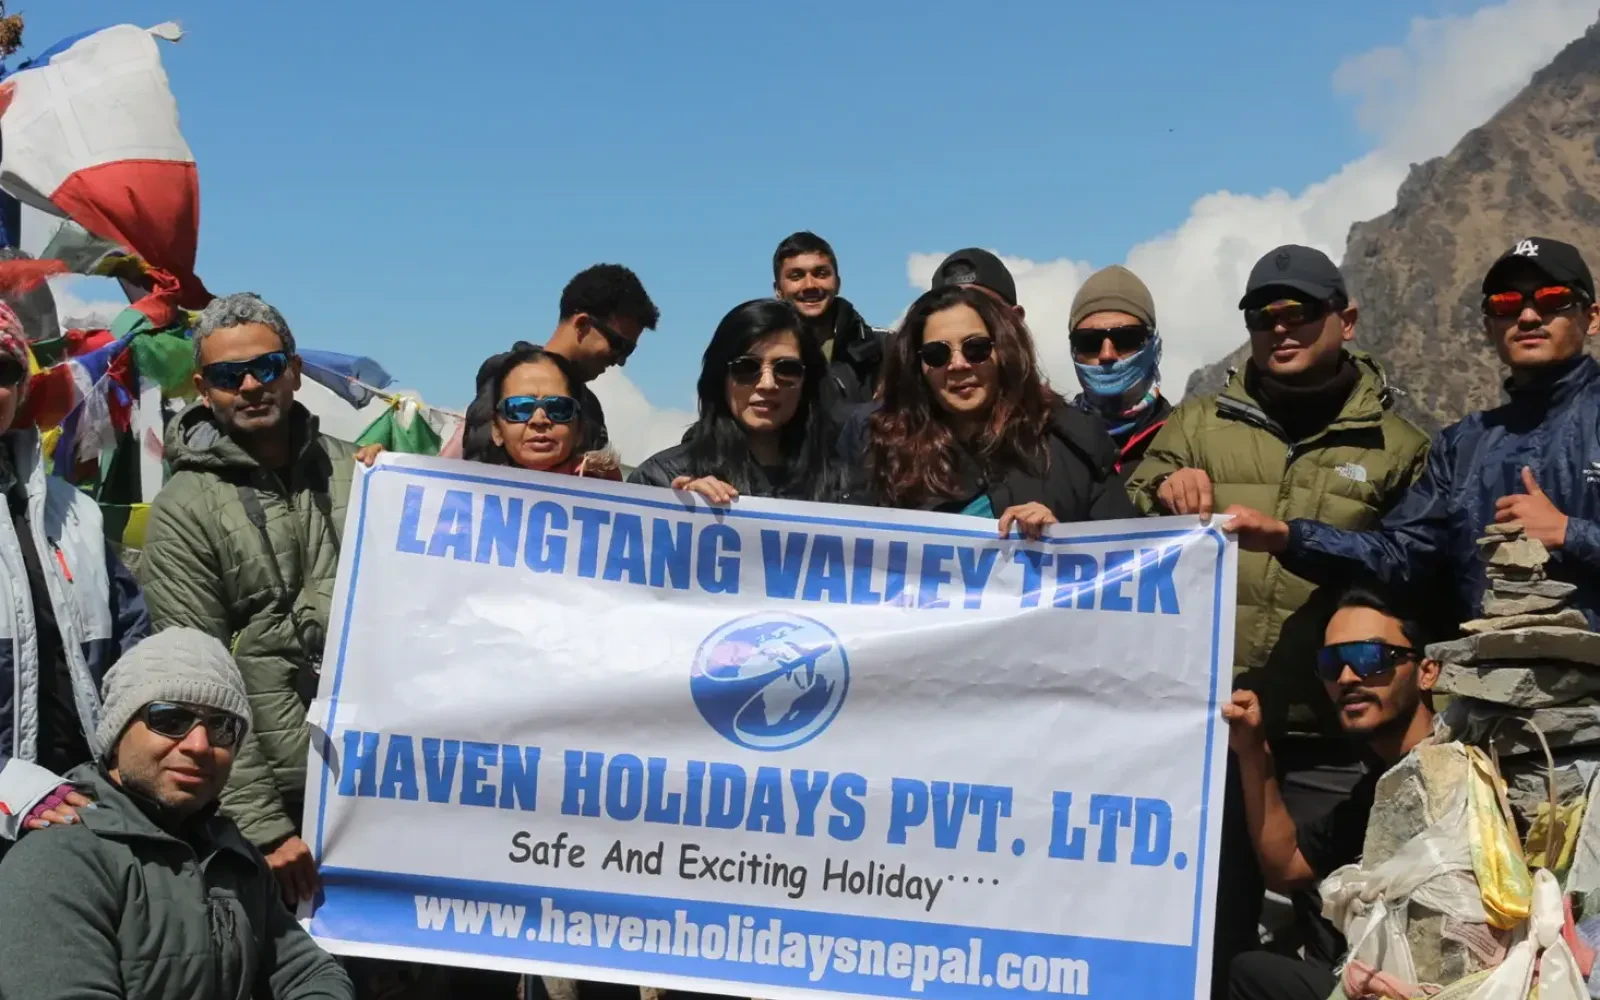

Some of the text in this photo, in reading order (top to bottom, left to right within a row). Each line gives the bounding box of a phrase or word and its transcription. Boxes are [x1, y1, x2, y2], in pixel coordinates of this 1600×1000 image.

[1513, 239, 1539, 257] LA
[395, 484, 1184, 615] LANGTANG VALLEY TREK
[338, 729, 1189, 871] HAVEN HOLIDAYS PVT. LTD.
[508, 830, 586, 869] Safe
[601, 839, 665, 876] And
[678, 843, 808, 899] Exciting
[413, 894, 1090, 997] www.havenholidaysnepal.com
